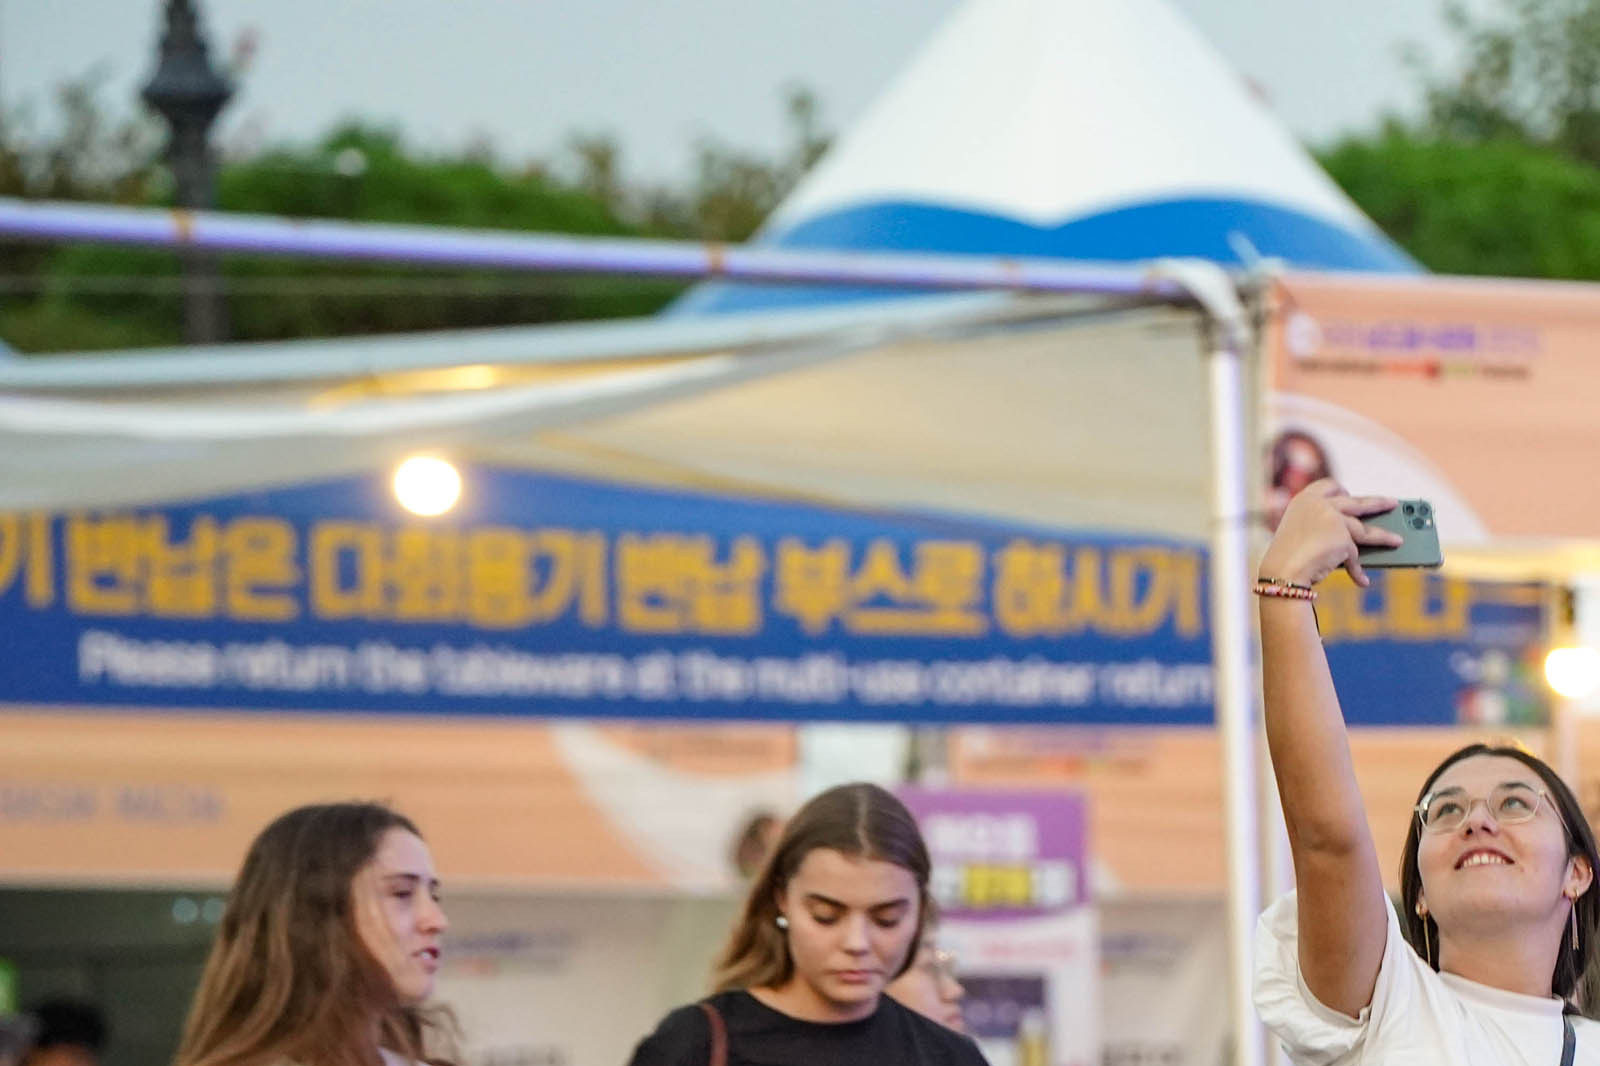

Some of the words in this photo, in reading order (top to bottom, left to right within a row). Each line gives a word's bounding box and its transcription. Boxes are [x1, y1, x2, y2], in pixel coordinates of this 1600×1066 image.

[65, 514, 300, 621] 반납은
[309, 520, 608, 629] 다회용기
[616, 532, 766, 636] 반납
[775, 538, 988, 636] 부스로
[994, 540, 1203, 638] 하시기
[80, 630, 217, 689] Please
[225, 640, 351, 691] return
[357, 639, 427, 693] the
[432, 644, 624, 698] tableware
[631, 649, 675, 701] at
[679, 650, 753, 701] the
[928, 656, 1093, 706] container
